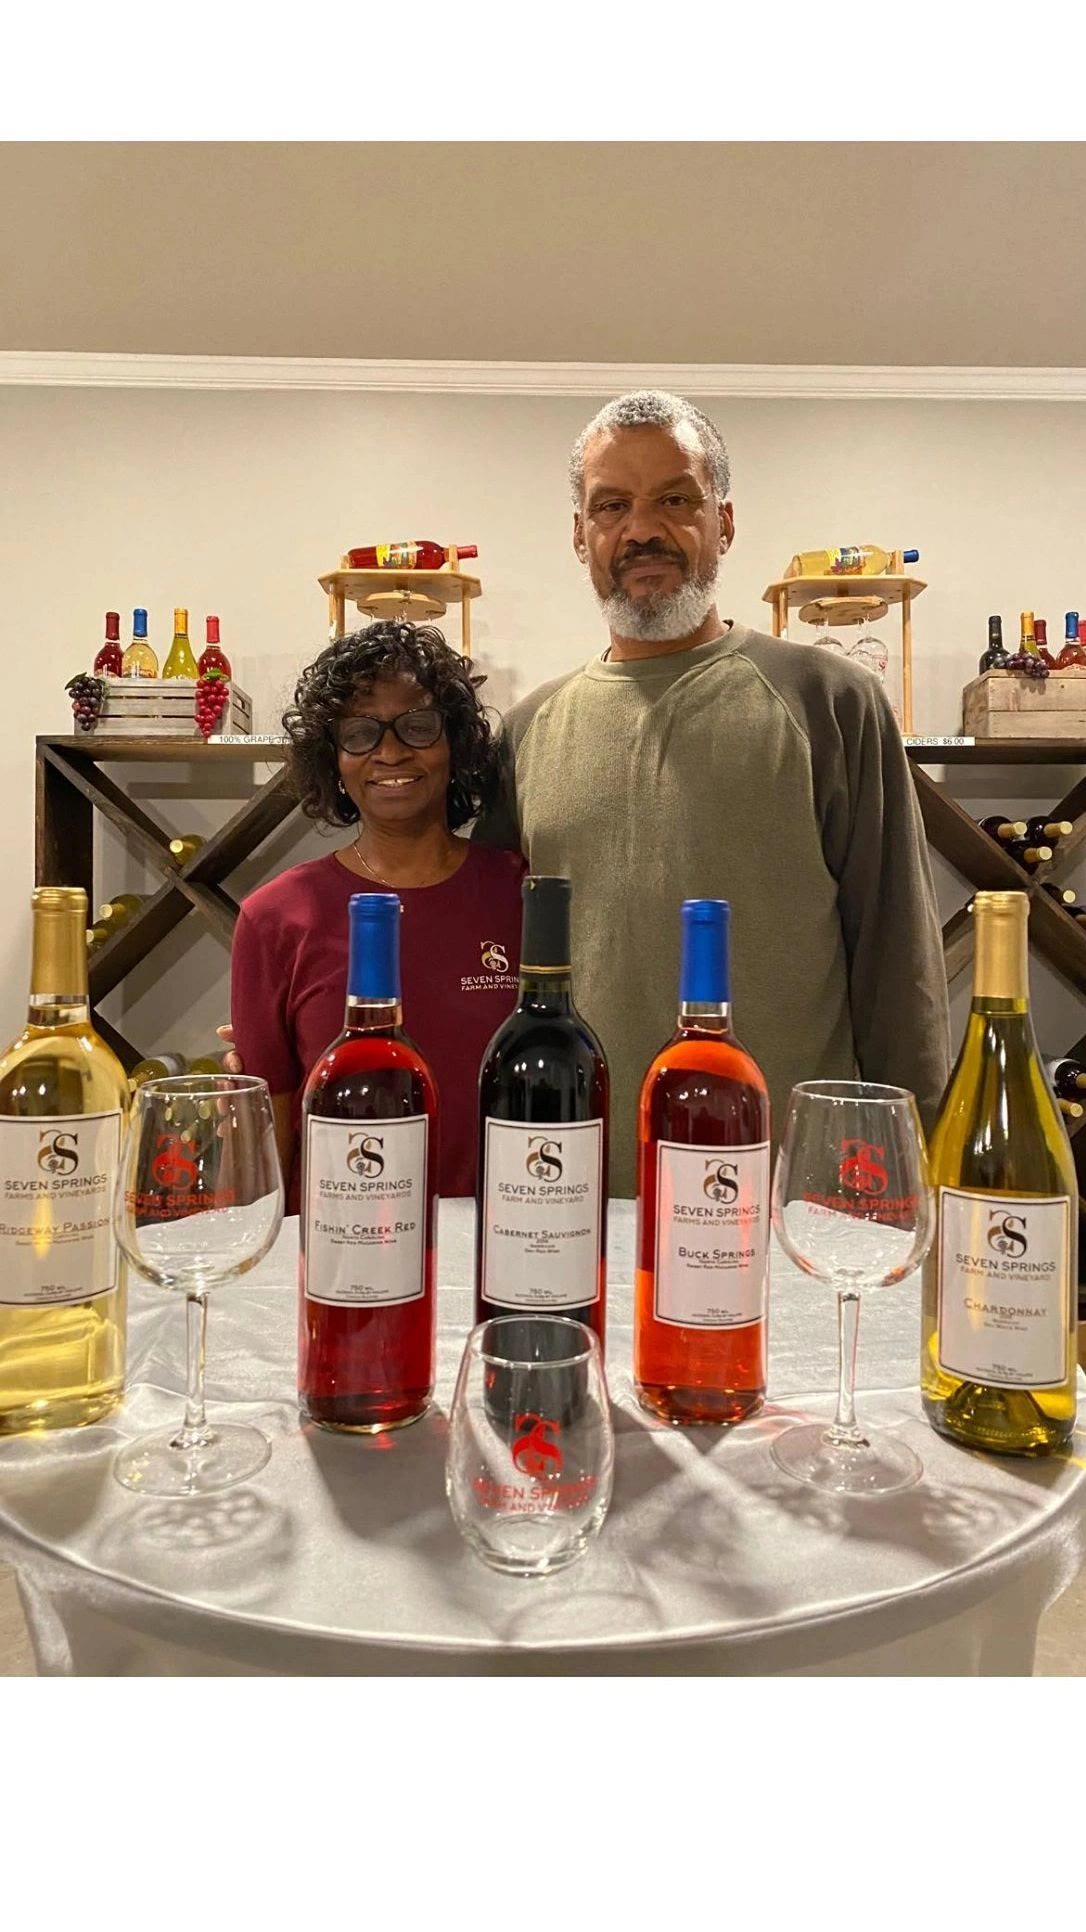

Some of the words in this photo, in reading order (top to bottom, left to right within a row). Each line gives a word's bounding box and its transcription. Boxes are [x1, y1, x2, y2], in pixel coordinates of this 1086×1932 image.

[220, 735, 241, 743] 100%
[243, 735, 273, 744] GRAPE
[906, 737, 939, 746] CIDERS
[460, 975, 493, 985] SEVEN
[494, 975, 520, 984] SPRIN
[461, 983, 482, 991] FARM
[4, 1180, 49, 1191] SEVEN
[52, 1173, 108, 1190] SPRINGS
[319, 1179, 357, 1192] SEVEN
[360, 1178, 413, 1192] SPRINGS
[497, 1182, 536, 1196] SEVEN
[538, 1183, 590, 1196] SPRINGS
[58, 1185, 107, 1199] VINEYARDS
[344, 1191, 364, 1201] AND
[366, 1190, 412, 1201] VINEYARDS
[501, 1195, 523, 1203] FARM
[525, 1197, 543, 1205] AND
[545, 1195, 585, 1205] VINEYARD
[673, 1204, 713, 1217] SEVEN
[716, 1204, 760, 1218] SPRINGS
[63, 1217, 111, 1233] PASSION
[352, 1224, 392, 1235] CREEK
[394, 1221, 416, 1233] RED
[702, 1218, 721, 1226] AND
[493, 1224, 539, 1239] CABERNET
[541, 1228, 591, 1239] SAUVIGNON
[678, 1246, 710, 1259] BUCK
[712, 1248, 756, 1260] SPRINGS
[955, 1253, 999, 1270] SEVEN
[1001, 1261, 1057, 1273] SPRINGS
[986, 1270, 1007, 1280] AND
[1008, 1272, 1051, 1282] VINEYARD
[963, 1297, 1049, 1318] CHARDONNAY
